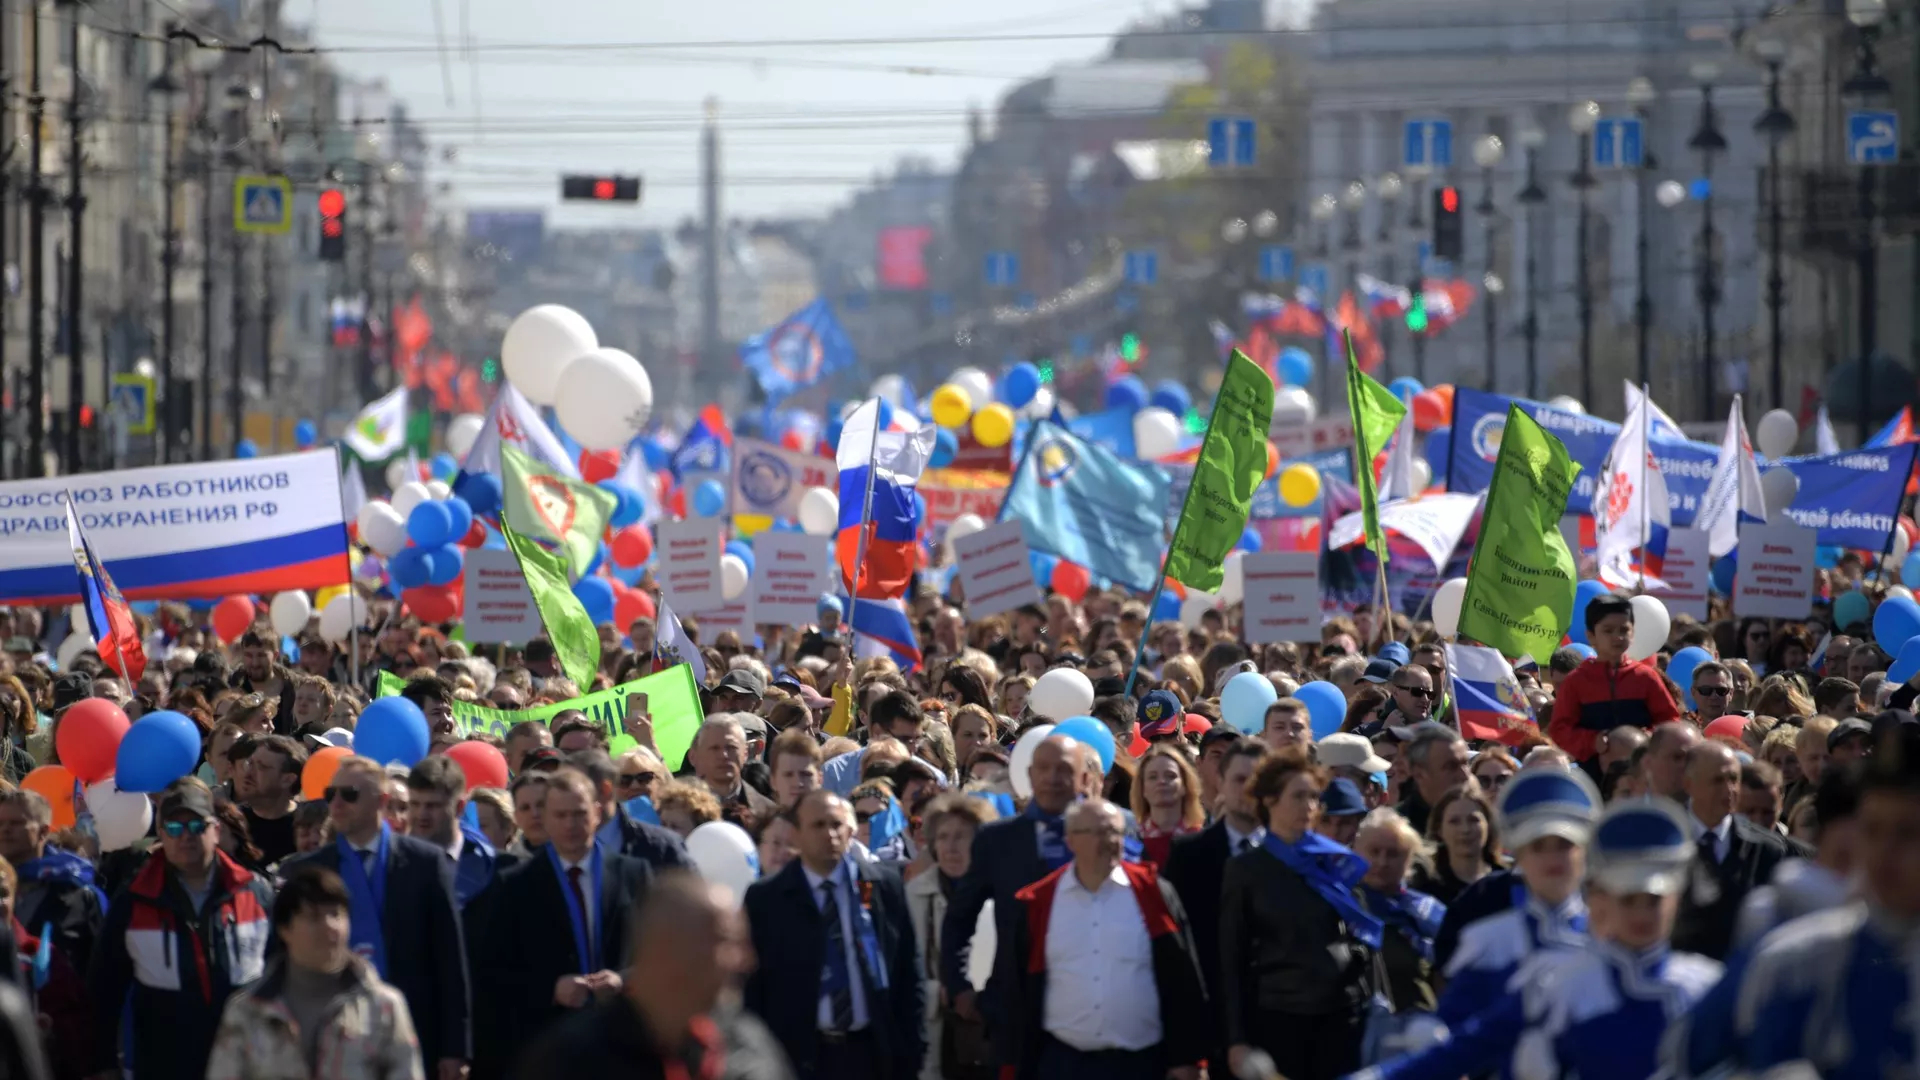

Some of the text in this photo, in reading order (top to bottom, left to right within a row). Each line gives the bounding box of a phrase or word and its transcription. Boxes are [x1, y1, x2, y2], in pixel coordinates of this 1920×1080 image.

[121, 471, 290, 500] РАБОТНИКОВ
[245, 501, 279, 520] РФ
[1500, 572, 1538, 591] район
